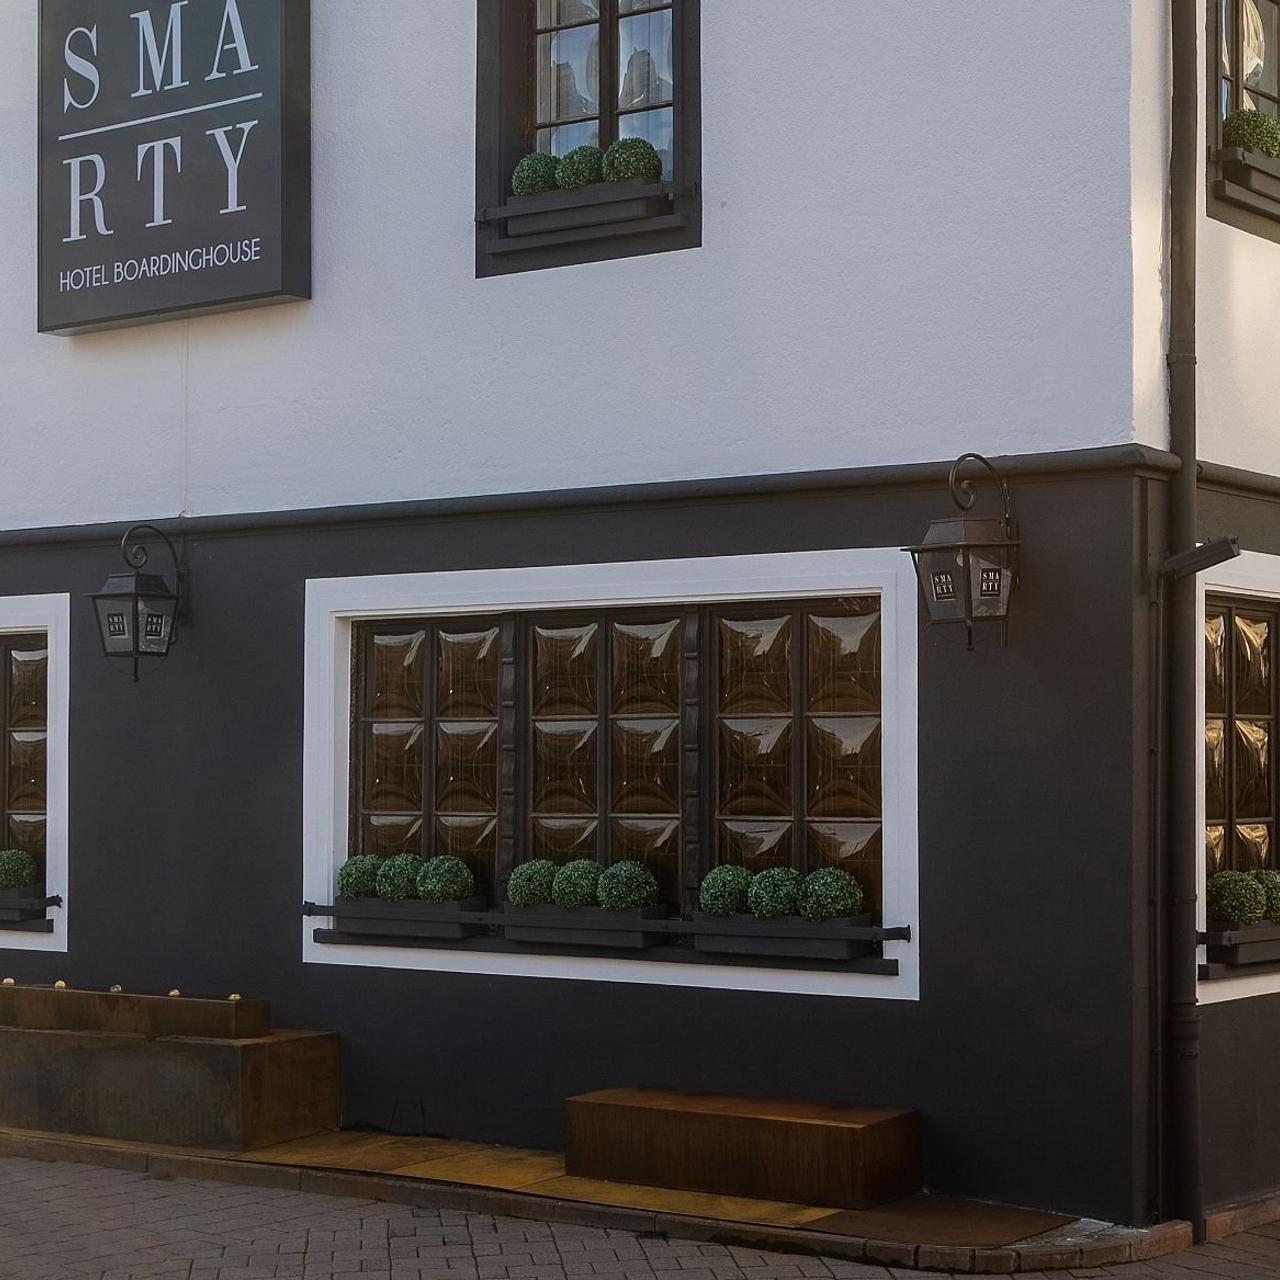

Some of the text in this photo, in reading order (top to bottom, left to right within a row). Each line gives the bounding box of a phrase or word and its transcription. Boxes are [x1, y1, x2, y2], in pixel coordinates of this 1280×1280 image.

[62, 119, 258, 243] RTY
[59, 237, 261, 292] HOTEL BOARDINGHOUSE
